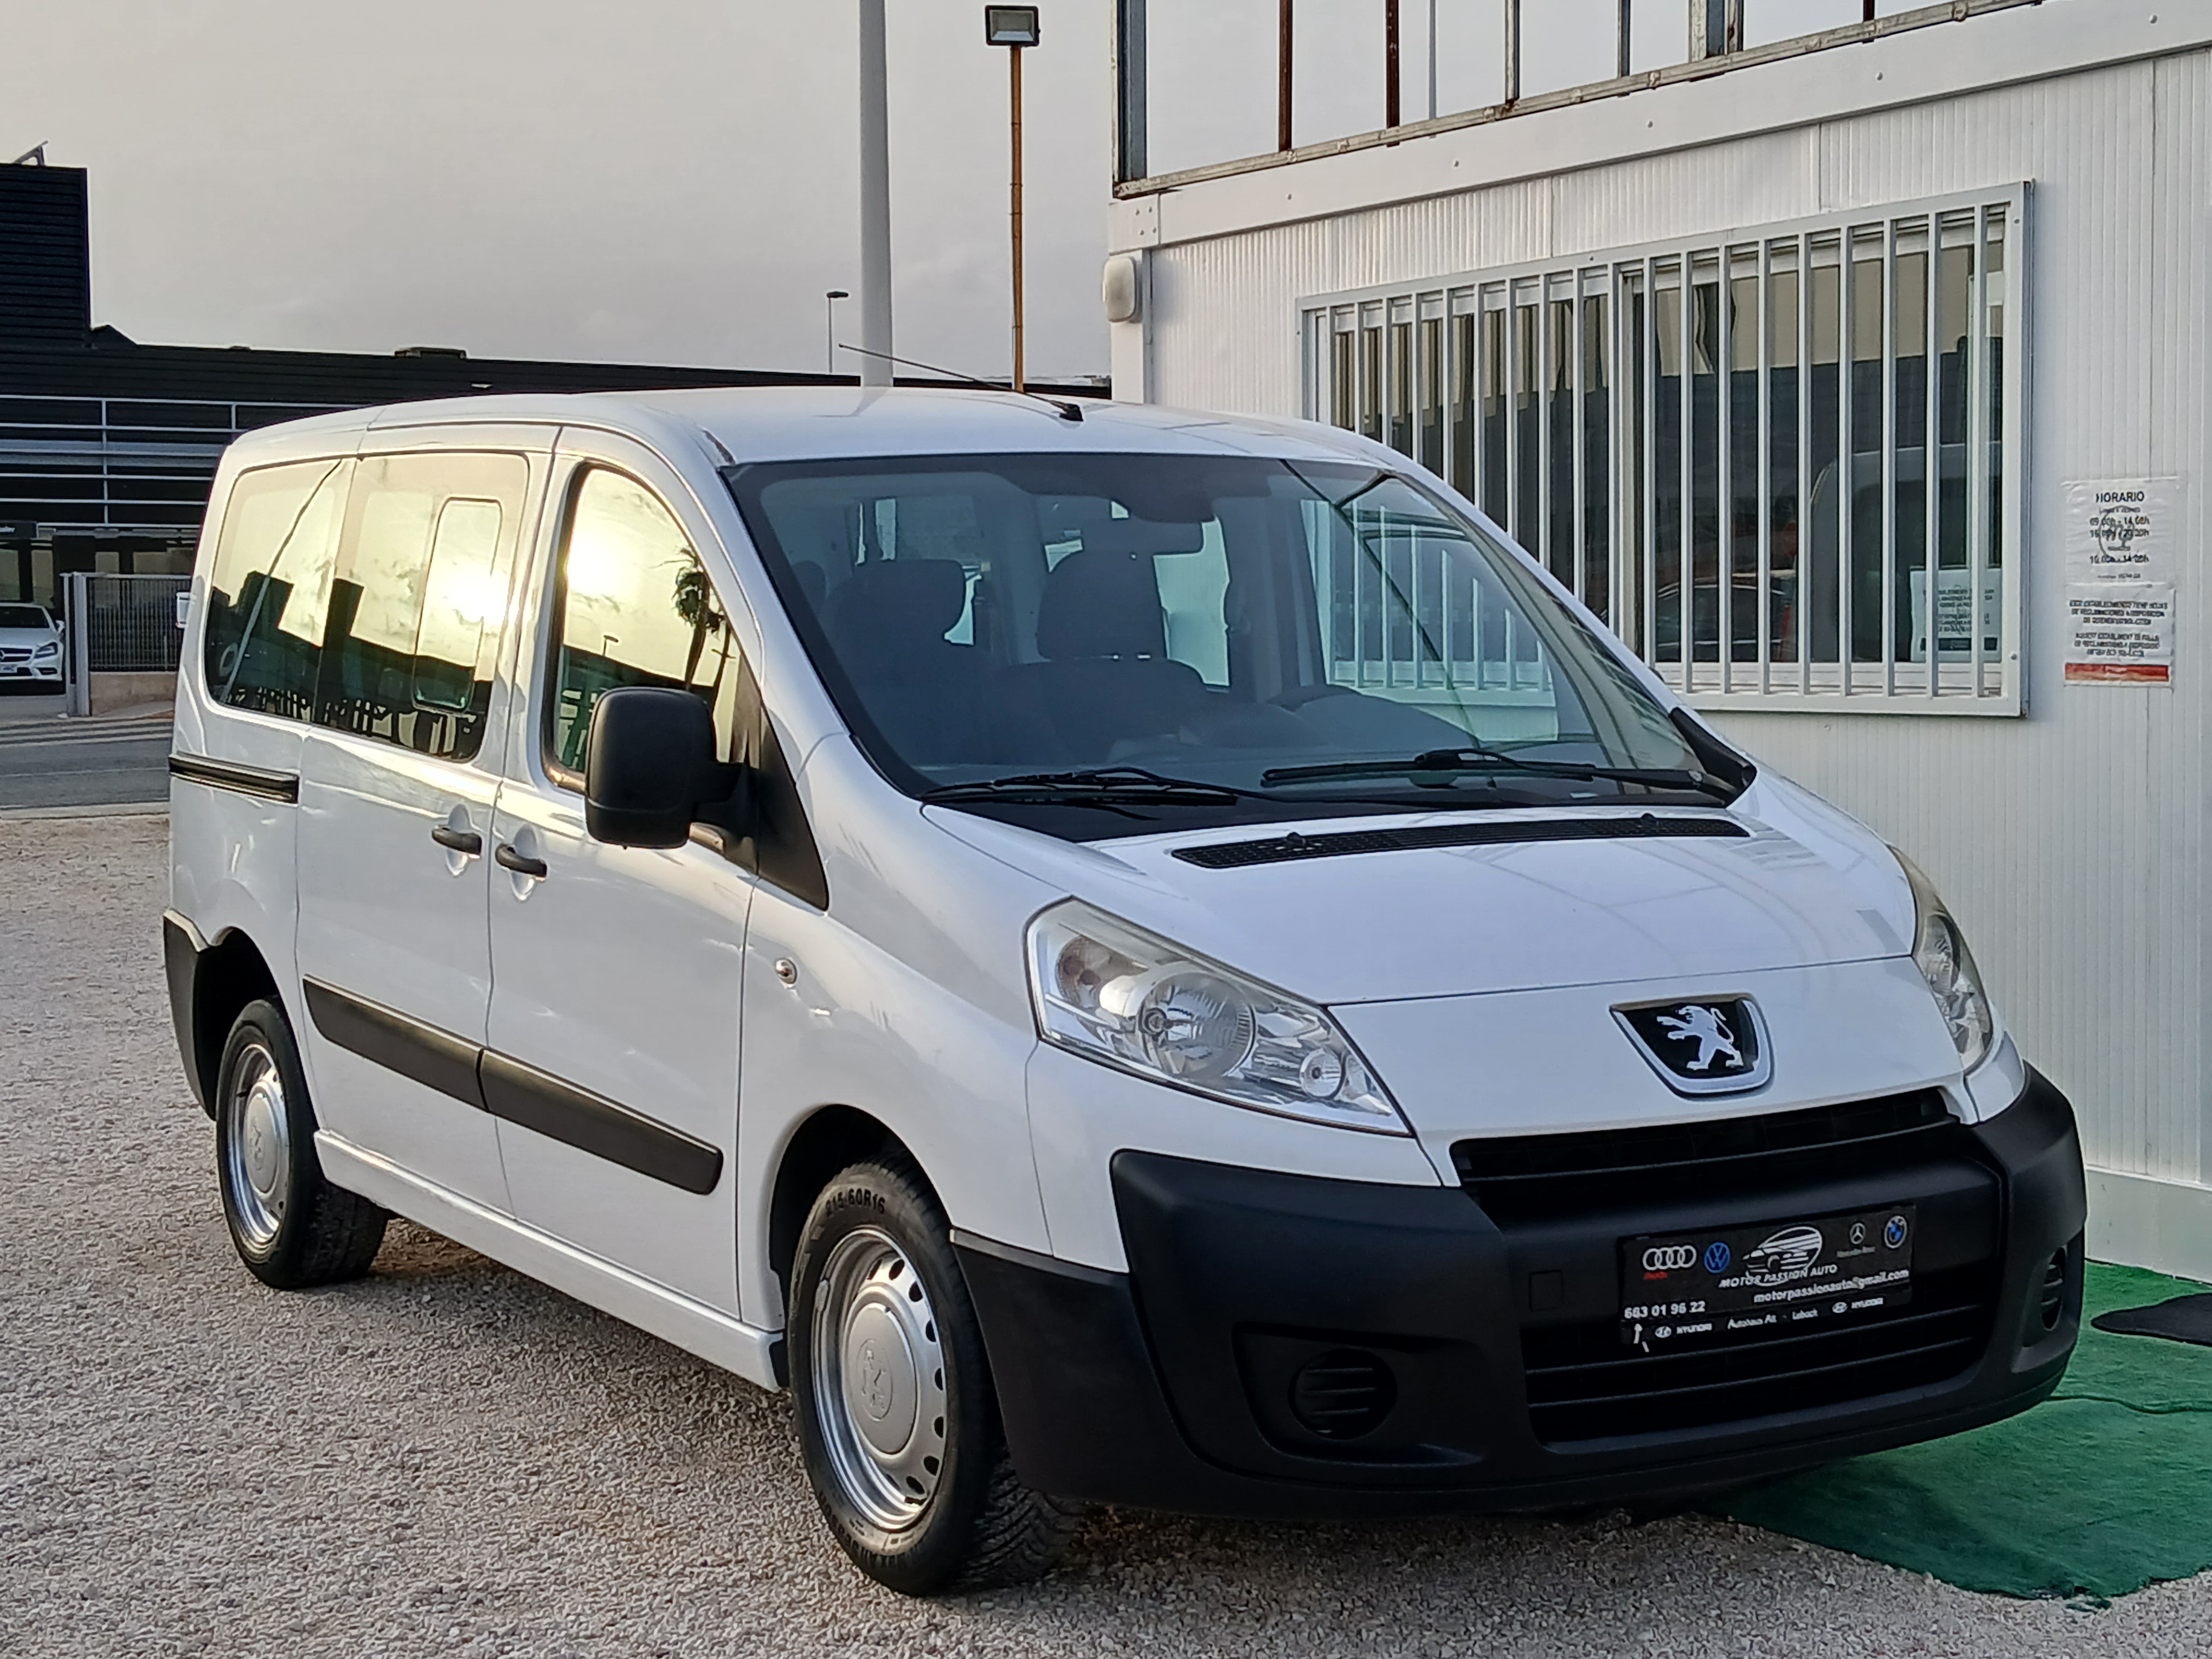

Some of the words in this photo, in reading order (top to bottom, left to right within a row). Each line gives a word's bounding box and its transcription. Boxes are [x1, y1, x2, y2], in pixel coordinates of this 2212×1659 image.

[2095, 491, 2145, 503] HORARIO
[1810, 1264, 1838, 1277] AUTO
[1651, 1304, 1666, 1316] 01
[1689, 1301, 1706, 1313] 22
